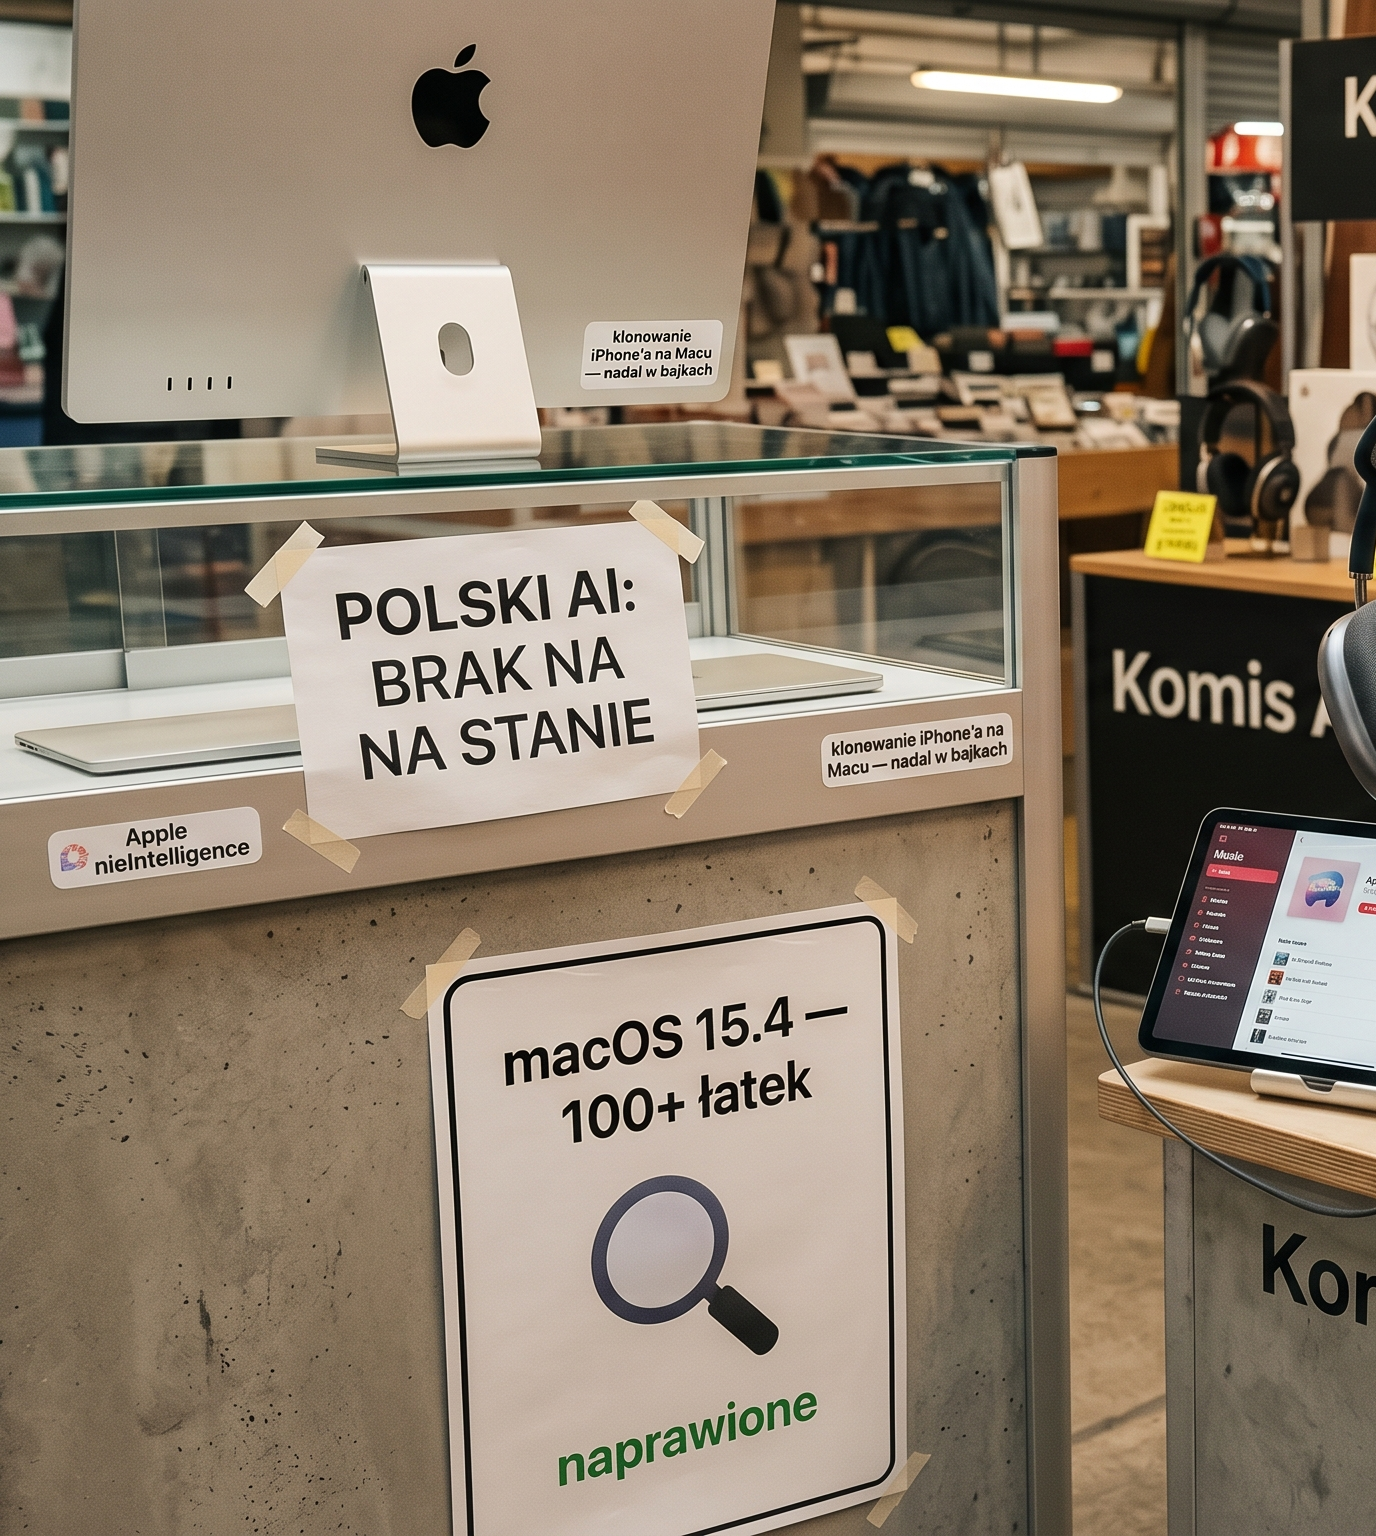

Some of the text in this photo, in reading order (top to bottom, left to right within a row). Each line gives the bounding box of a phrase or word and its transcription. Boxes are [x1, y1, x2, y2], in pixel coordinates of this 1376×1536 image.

[592, 347, 711, 361] iPhone'a na Macu
[613, 329, 691, 343] klonowanie
[604, 365, 642, 378] nadal
[646, 369, 657, 377] w
[661, 363, 712, 379] bajkach
[336, 568, 635, 640] POLSKI AI:
[372, 637, 625, 707] BRAK NA
[1113, 647, 1297, 734] Komis
[360, 698, 654, 780] NA STANIE
[828, 763, 868, 778] Macu
[892, 751, 931, 769] nadal
[935, 752, 947, 763] w
[952, 742, 1007, 762] bajkach
[920, 725, 982, 745] iPhone'a
[987, 725, 1003, 737] na
[95, 841, 250, 875] nieIntelligence
[126, 823, 188, 847] Apple
[505, 1015, 682, 1086] macOS
[697, 996, 793, 1050] 15.4
[563, 1060, 812, 1143] 100+ łatek
[559, 1393, 816, 1486] naprawione
